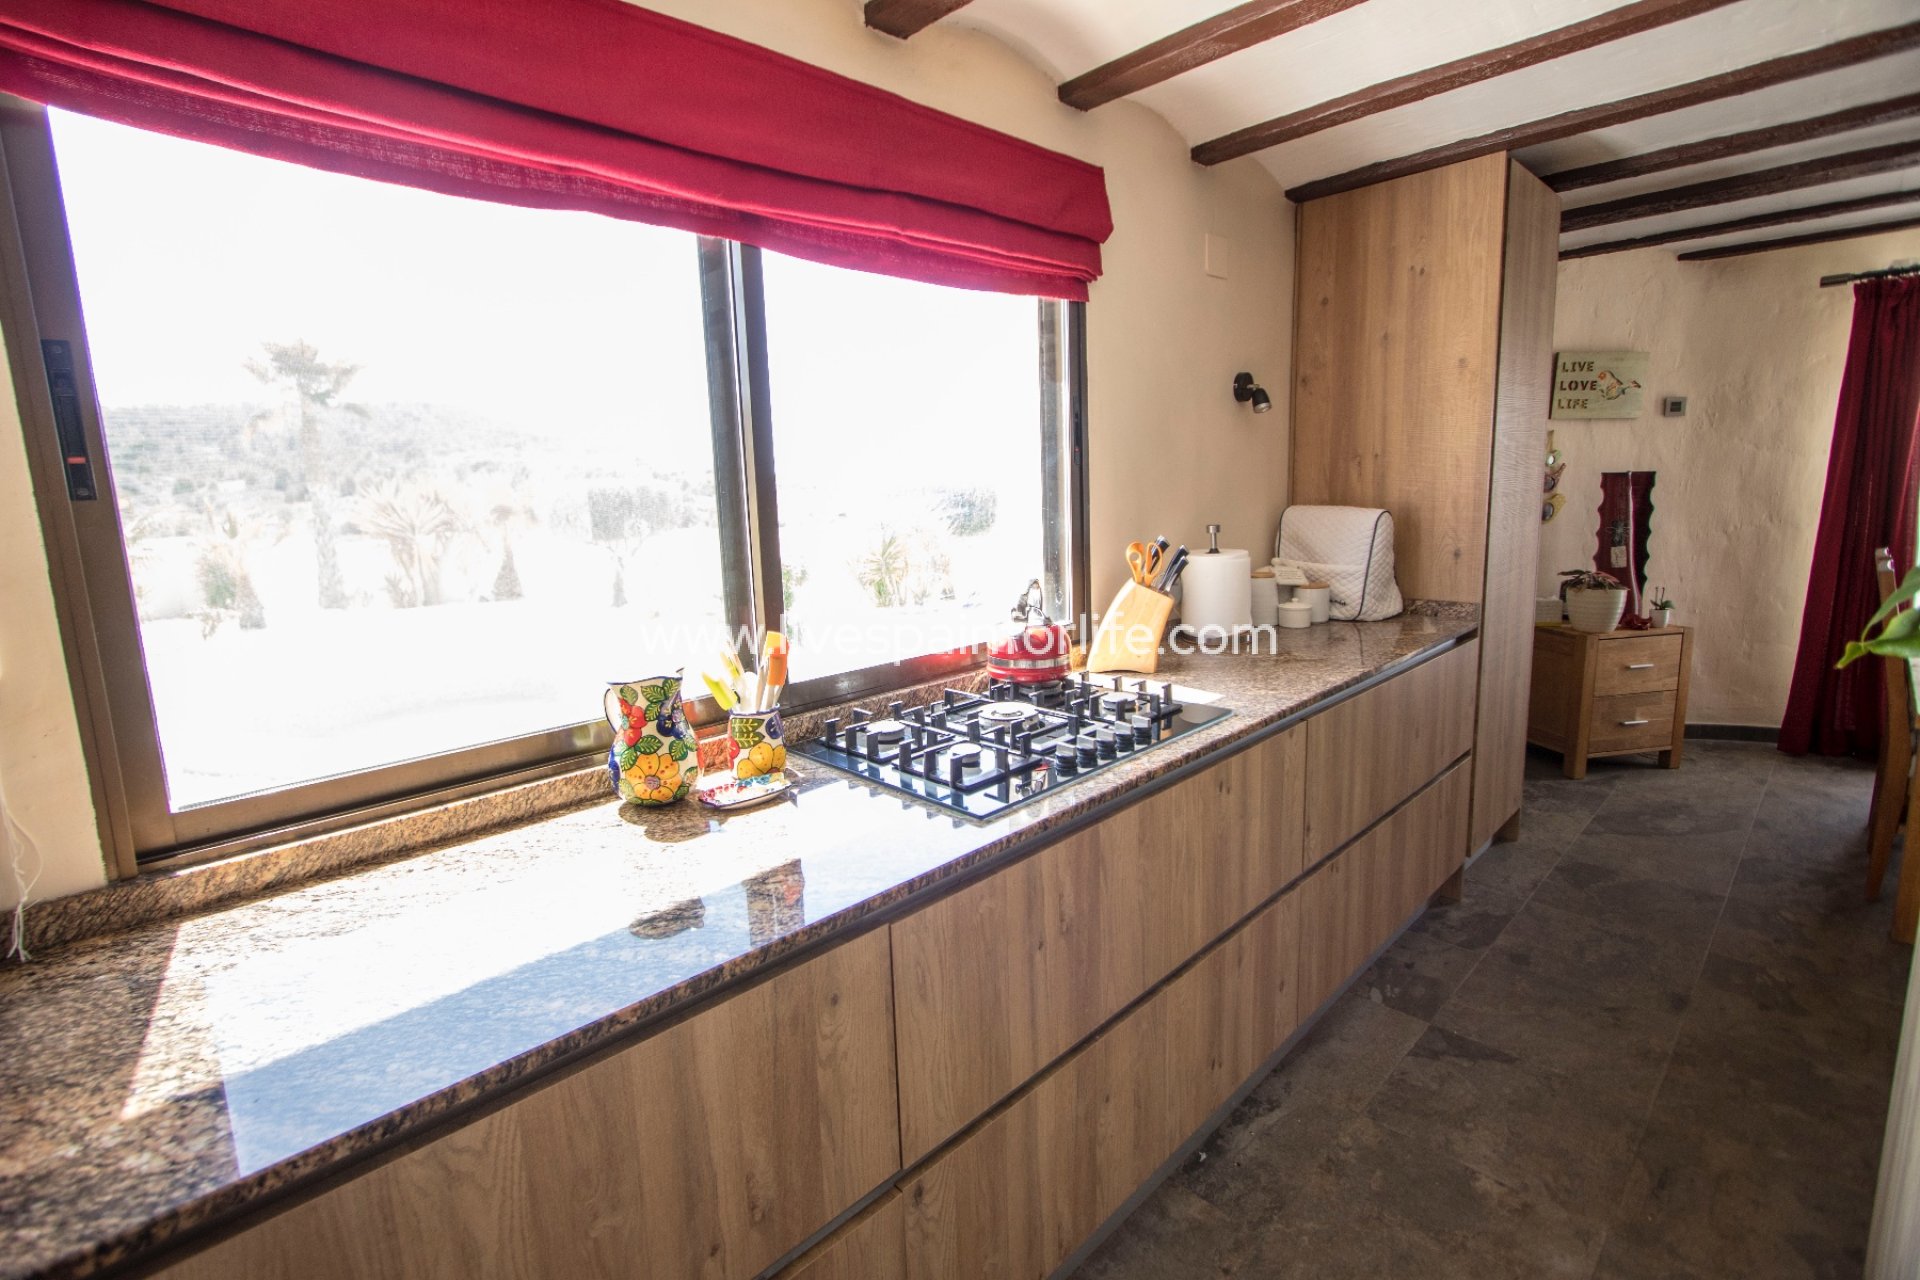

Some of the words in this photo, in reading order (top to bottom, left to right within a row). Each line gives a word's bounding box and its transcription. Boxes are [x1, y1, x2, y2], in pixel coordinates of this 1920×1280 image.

[1562, 361, 1595, 373] LIVE
[1560, 380, 1598, 391] LOVE
[1557, 398, 1589, 409] LIFE
